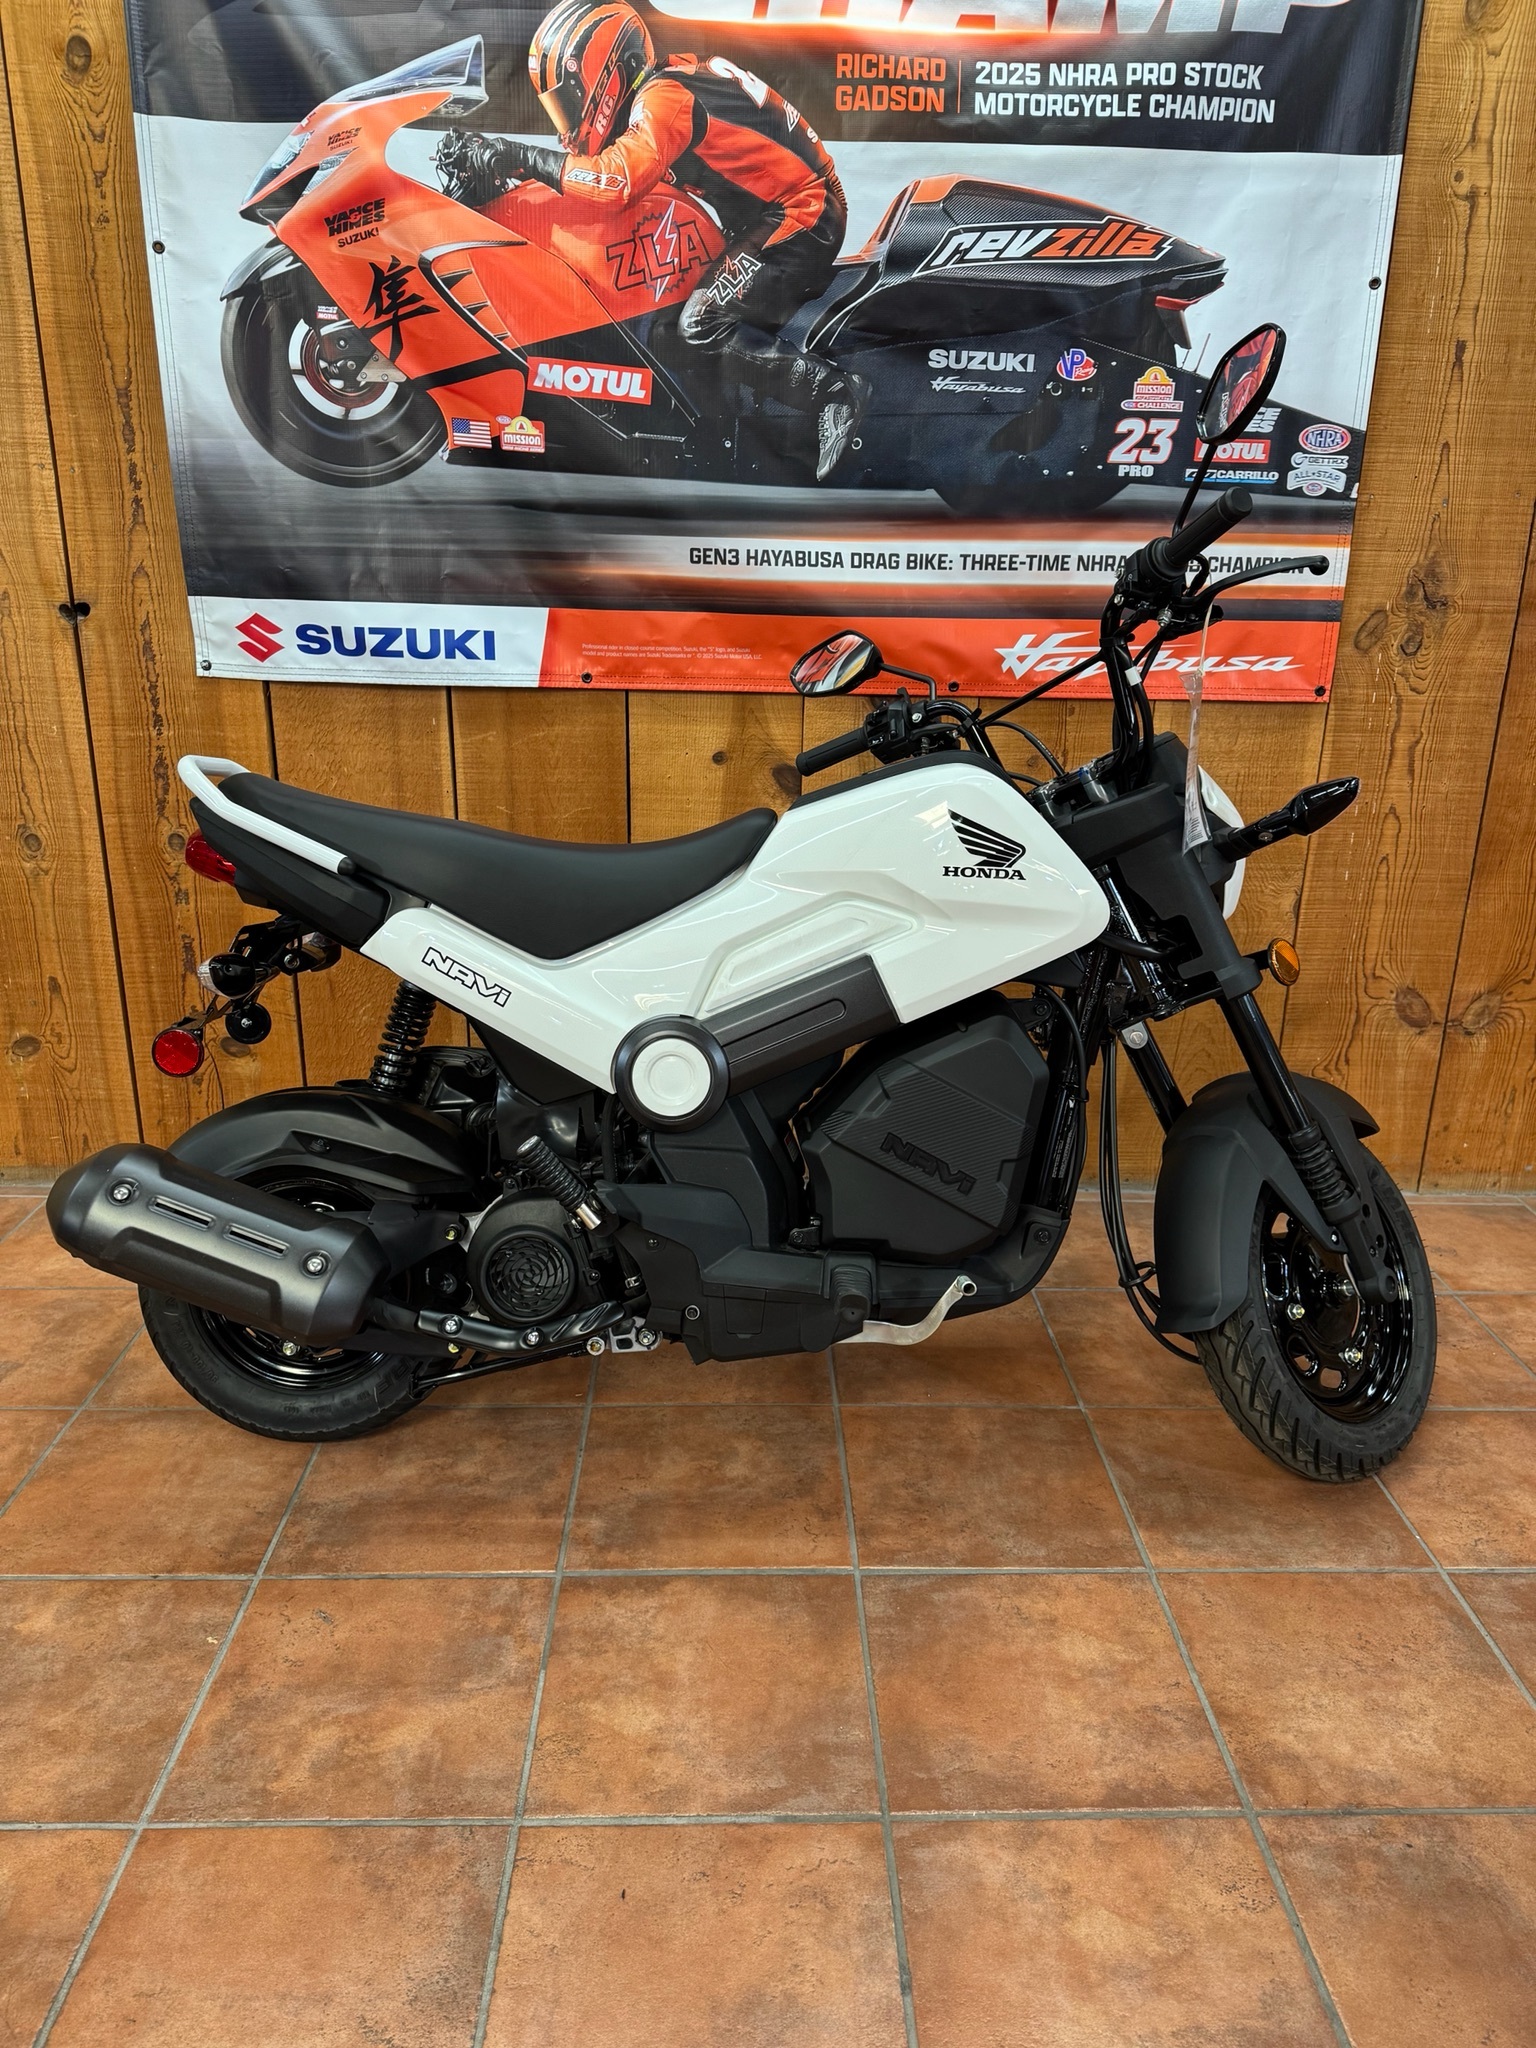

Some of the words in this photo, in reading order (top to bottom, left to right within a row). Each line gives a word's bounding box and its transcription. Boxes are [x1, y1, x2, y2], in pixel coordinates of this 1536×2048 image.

[835, 53, 946, 82] RICHARD
[974, 61, 1041, 87] 2025
[1048, 61, 1118, 88] NHRA
[1126, 62, 1176, 87] PRO
[1184, 62, 1265, 90] STOCK
[835, 85, 945, 113] GADSON
[974, 92, 1140, 119] MOTORCYCLE
[1148, 93, 1276, 124] CHAMPION
[324, 198, 386, 228] VANCE
[328, 210, 386, 237] HINES
[337, 227, 380, 248] SUZUKI
[361, 255, 440, 364] 隼
[927, 348, 1036, 373] SUZUKI
[1059, 348, 1087, 381] VP
[533, 363, 647, 399] MOTUL
[929, 375, 1027, 394] Hayabusa
[1137, 401, 1180, 410] CHALLENGE
[1107, 417, 1180, 464] 23
[1307, 429, 1342, 448] NHRA
[1117, 464, 1155, 478] PRO
[1216, 469, 1280, 481] CARRILLO
[689, 547, 740, 566] GEN3
[746, 549, 845, 569] HAYABUSA
[850, 552, 900, 570] DRAG
[906, 553, 954, 571] BIKE:
[959, 553, 1071, 572] THREE-TIME
[1077, 555, 1127, 572] NHRA
[295, 623, 497, 661] SUZUKI
[942, 865, 1027, 881] HONDA
